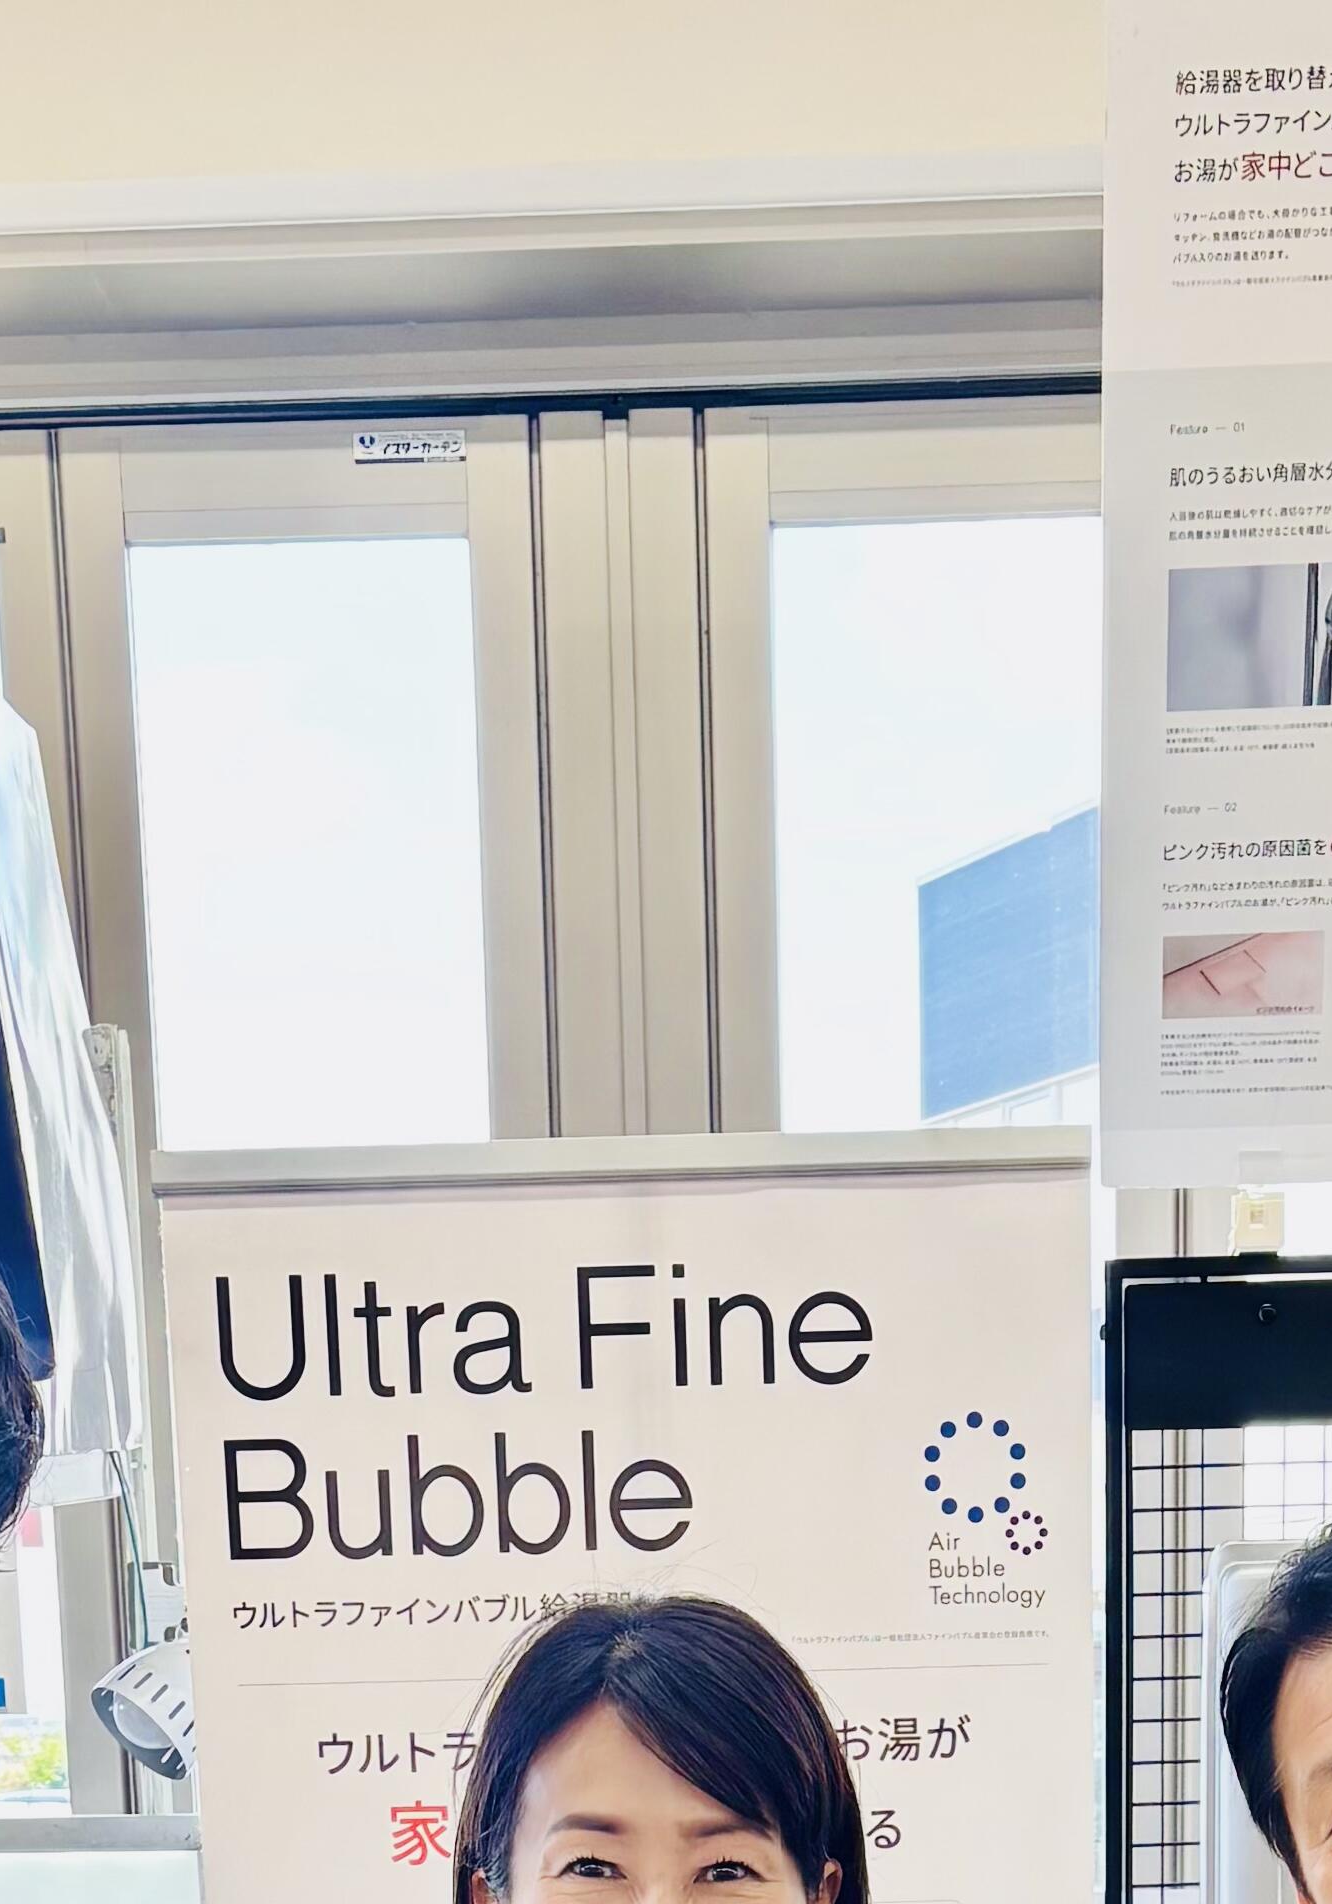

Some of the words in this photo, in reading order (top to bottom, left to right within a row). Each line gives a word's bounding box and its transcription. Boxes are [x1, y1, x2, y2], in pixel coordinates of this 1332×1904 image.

[215, 1273, 532, 1402] Ultra
[576, 1263, 873, 1391] Fine
[224, 1430, 693, 1562] Bubble
[929, 1531, 962, 1551] Air
[929, 1559, 1006, 1580] Bubble
[930, 1584, 1047, 1609] Technology
[838, 1714, 972, 1763] お湯が
[391, 1803, 451, 1865] 家
[867, 1807, 902, 1850] る
